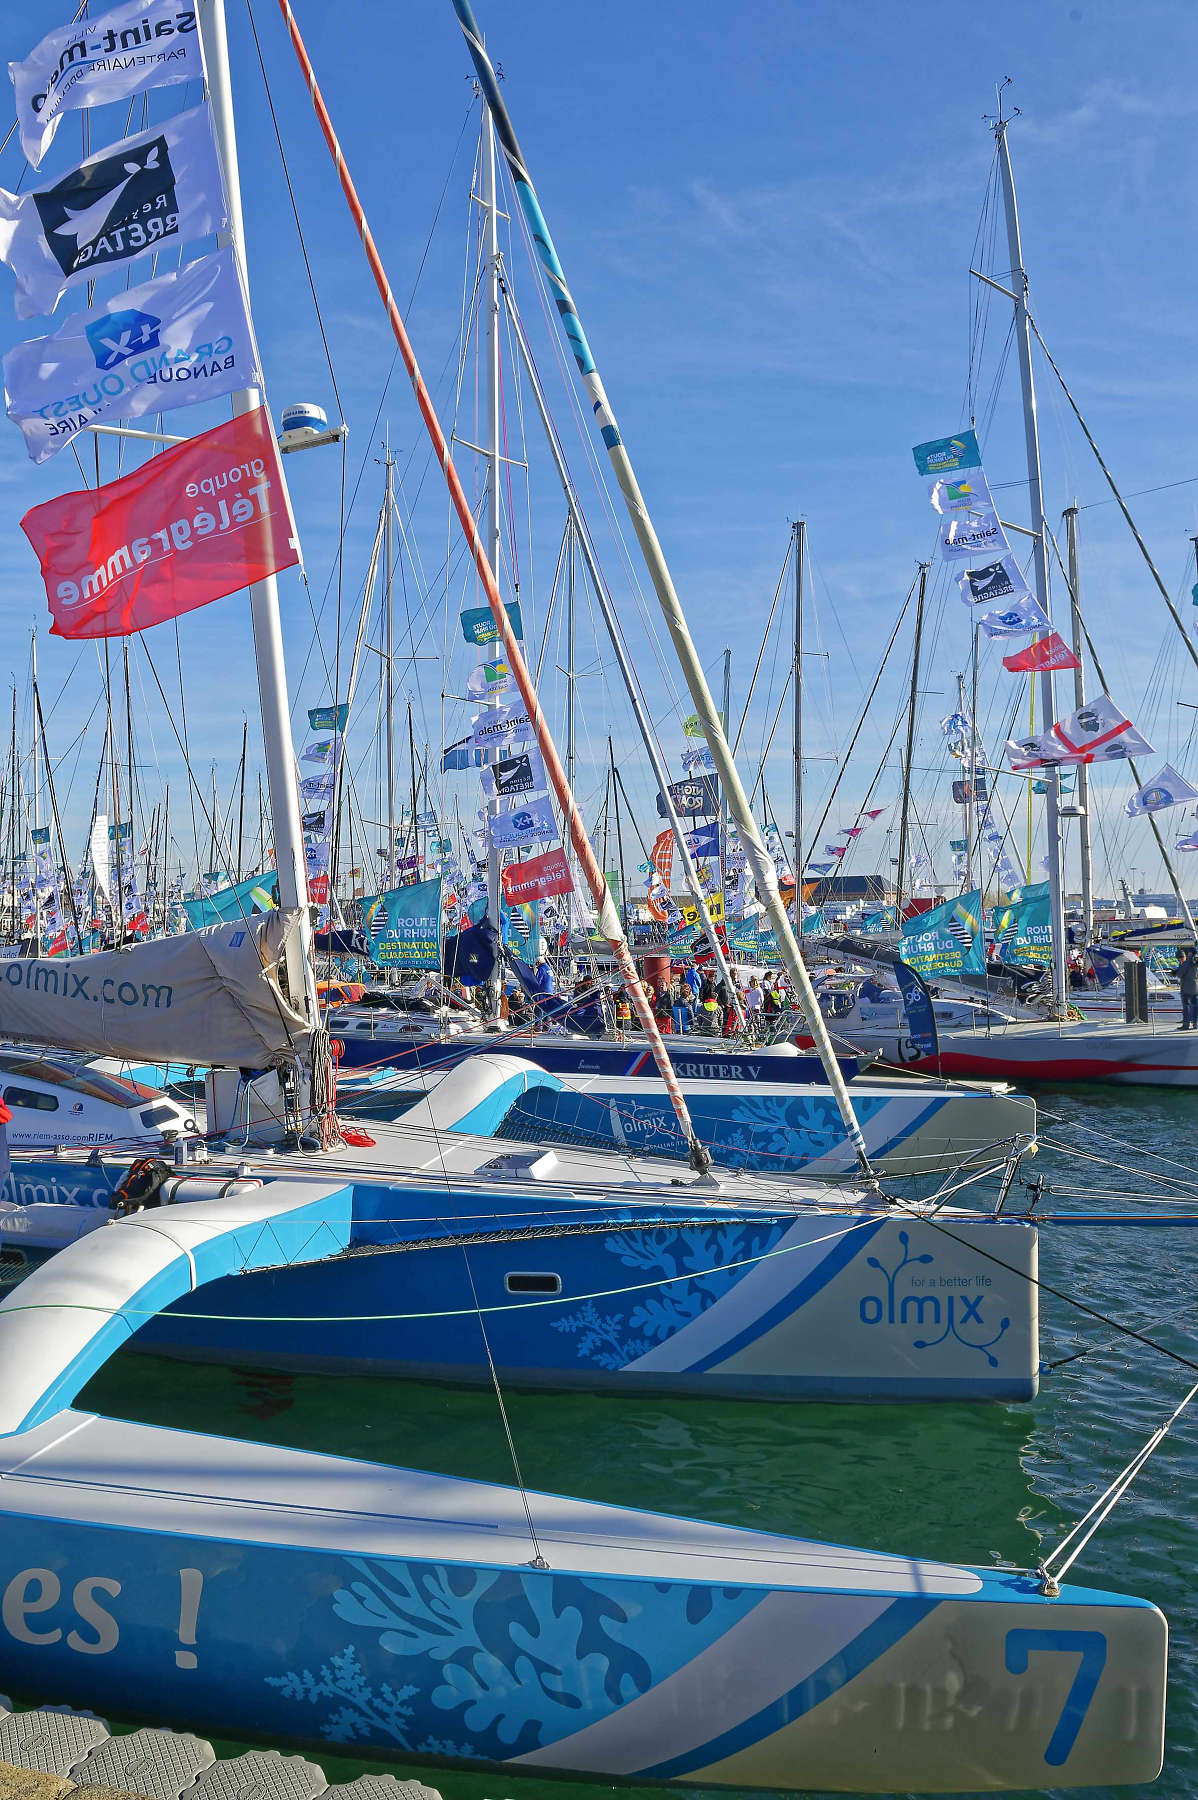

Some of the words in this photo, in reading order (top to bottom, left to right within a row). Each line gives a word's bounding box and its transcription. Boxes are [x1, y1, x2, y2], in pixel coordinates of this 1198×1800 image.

[398, 917, 437, 928] ROUTE
[387, 929, 401, 939] DU
[402, 928, 437, 939] RHUM
[1026, 925, 1052, 936] ROUT
[1016, 936, 1031, 945] DU
[1033, 934, 1053, 944] RHU
[378, 941, 437, 950] DESTINATION
[379, 951, 438, 960] GUADELOUPE
[671, 1062, 745, 1080] KRITER
[749, 1065, 762, 1081] V
[911, 1276, 926, 1287] for
[928, 1279, 936, 1287] a
[939, 1276, 973, 1287] better
[975, 1275, 992, 1287] life
[174, 1567, 204, 1670] !
[1004, 1627, 1108, 1768] 7
